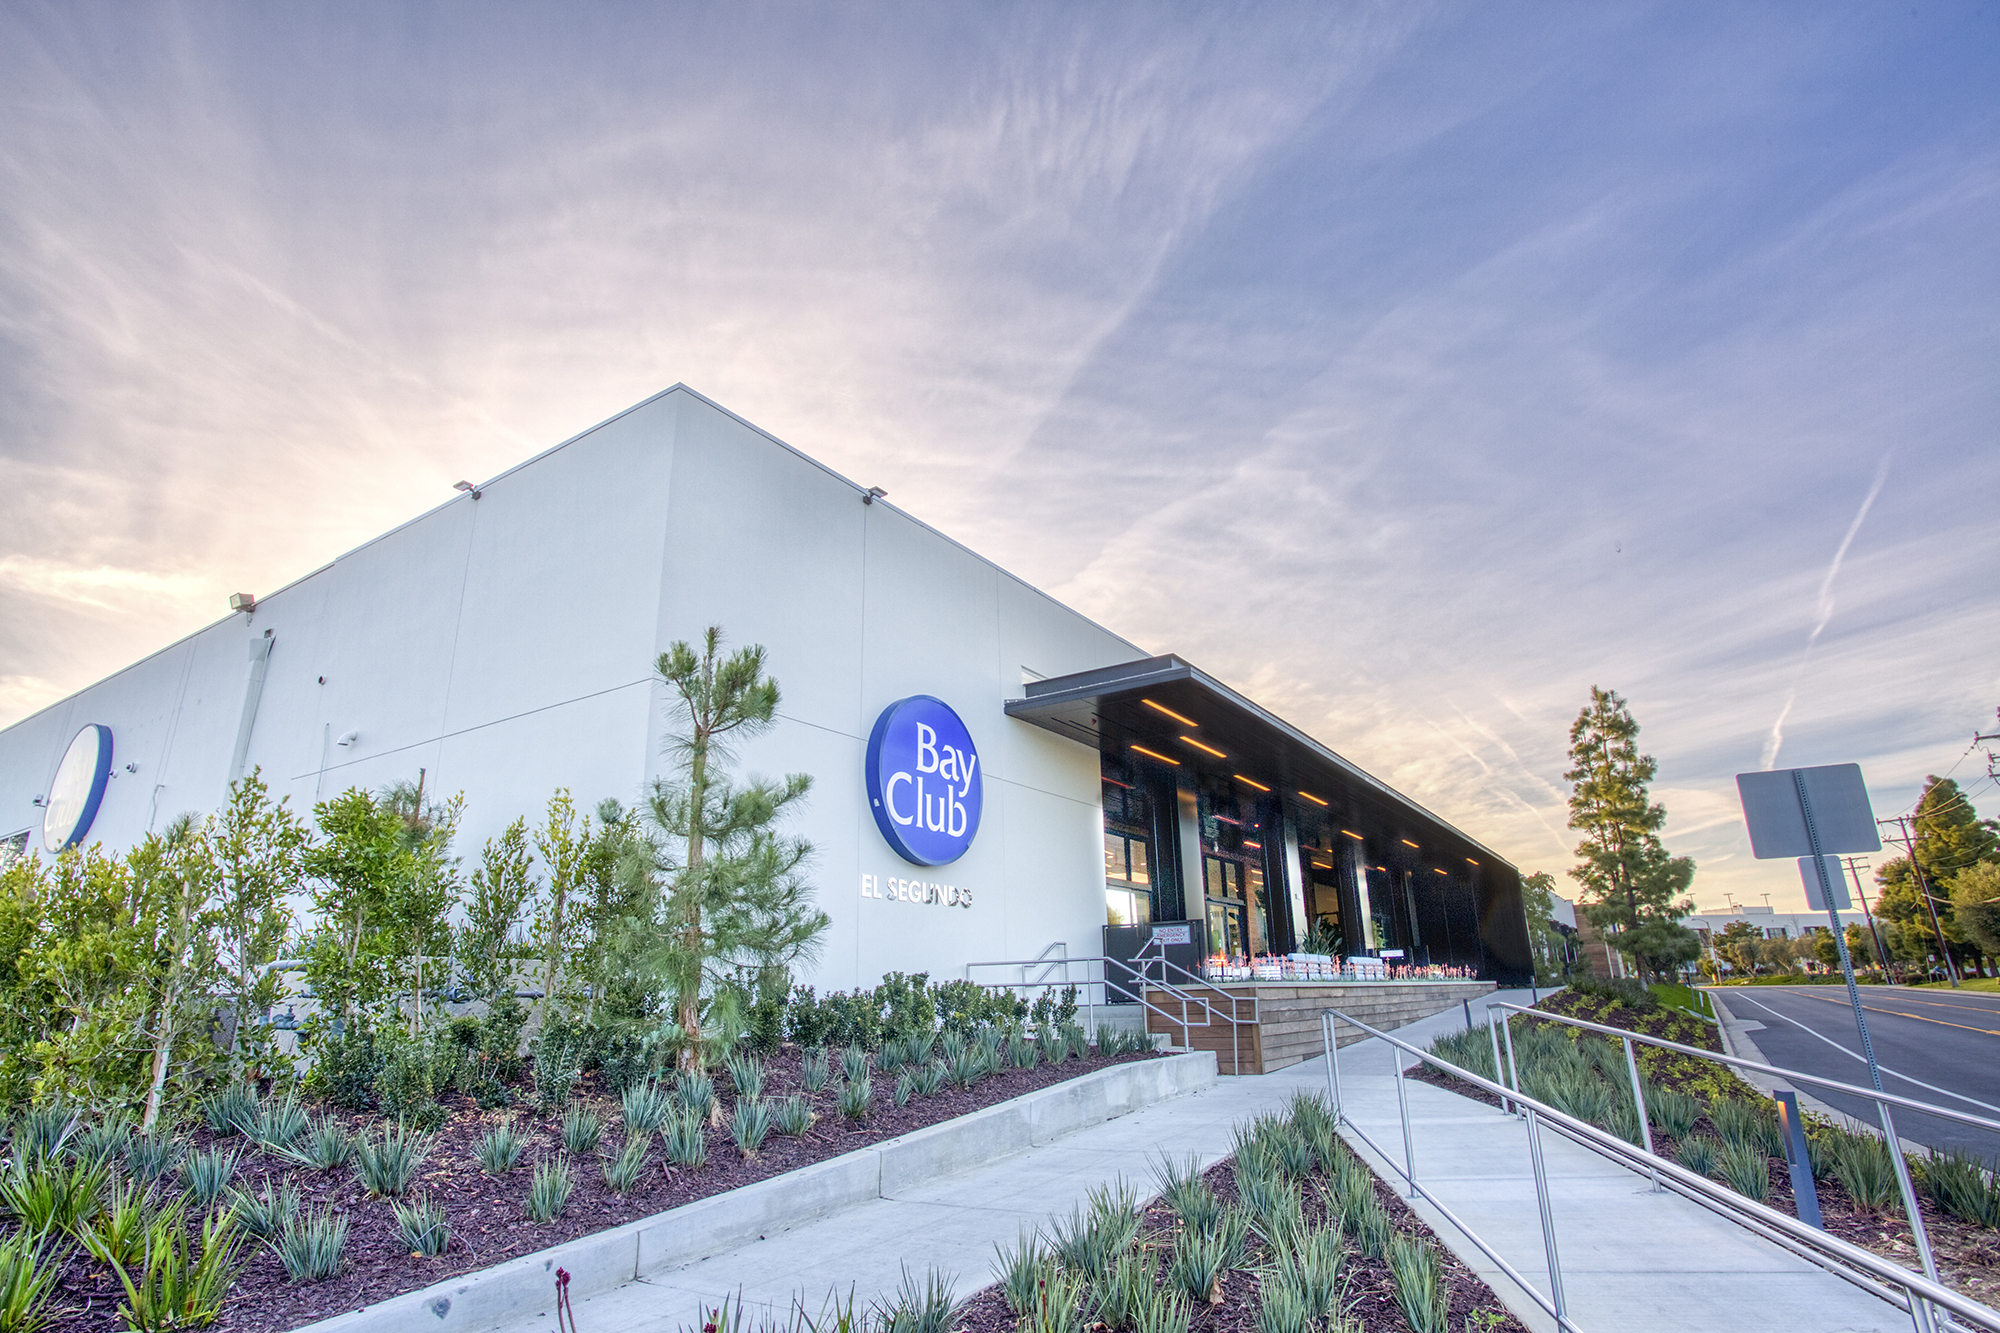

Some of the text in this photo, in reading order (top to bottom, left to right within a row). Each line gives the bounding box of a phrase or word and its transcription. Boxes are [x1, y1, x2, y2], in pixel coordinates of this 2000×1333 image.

[915, 721, 976, 798] Bay
[45, 786, 80, 833] Club
[886, 771, 967, 838] Club
[861, 873, 973, 908] EL SEGUNDO
